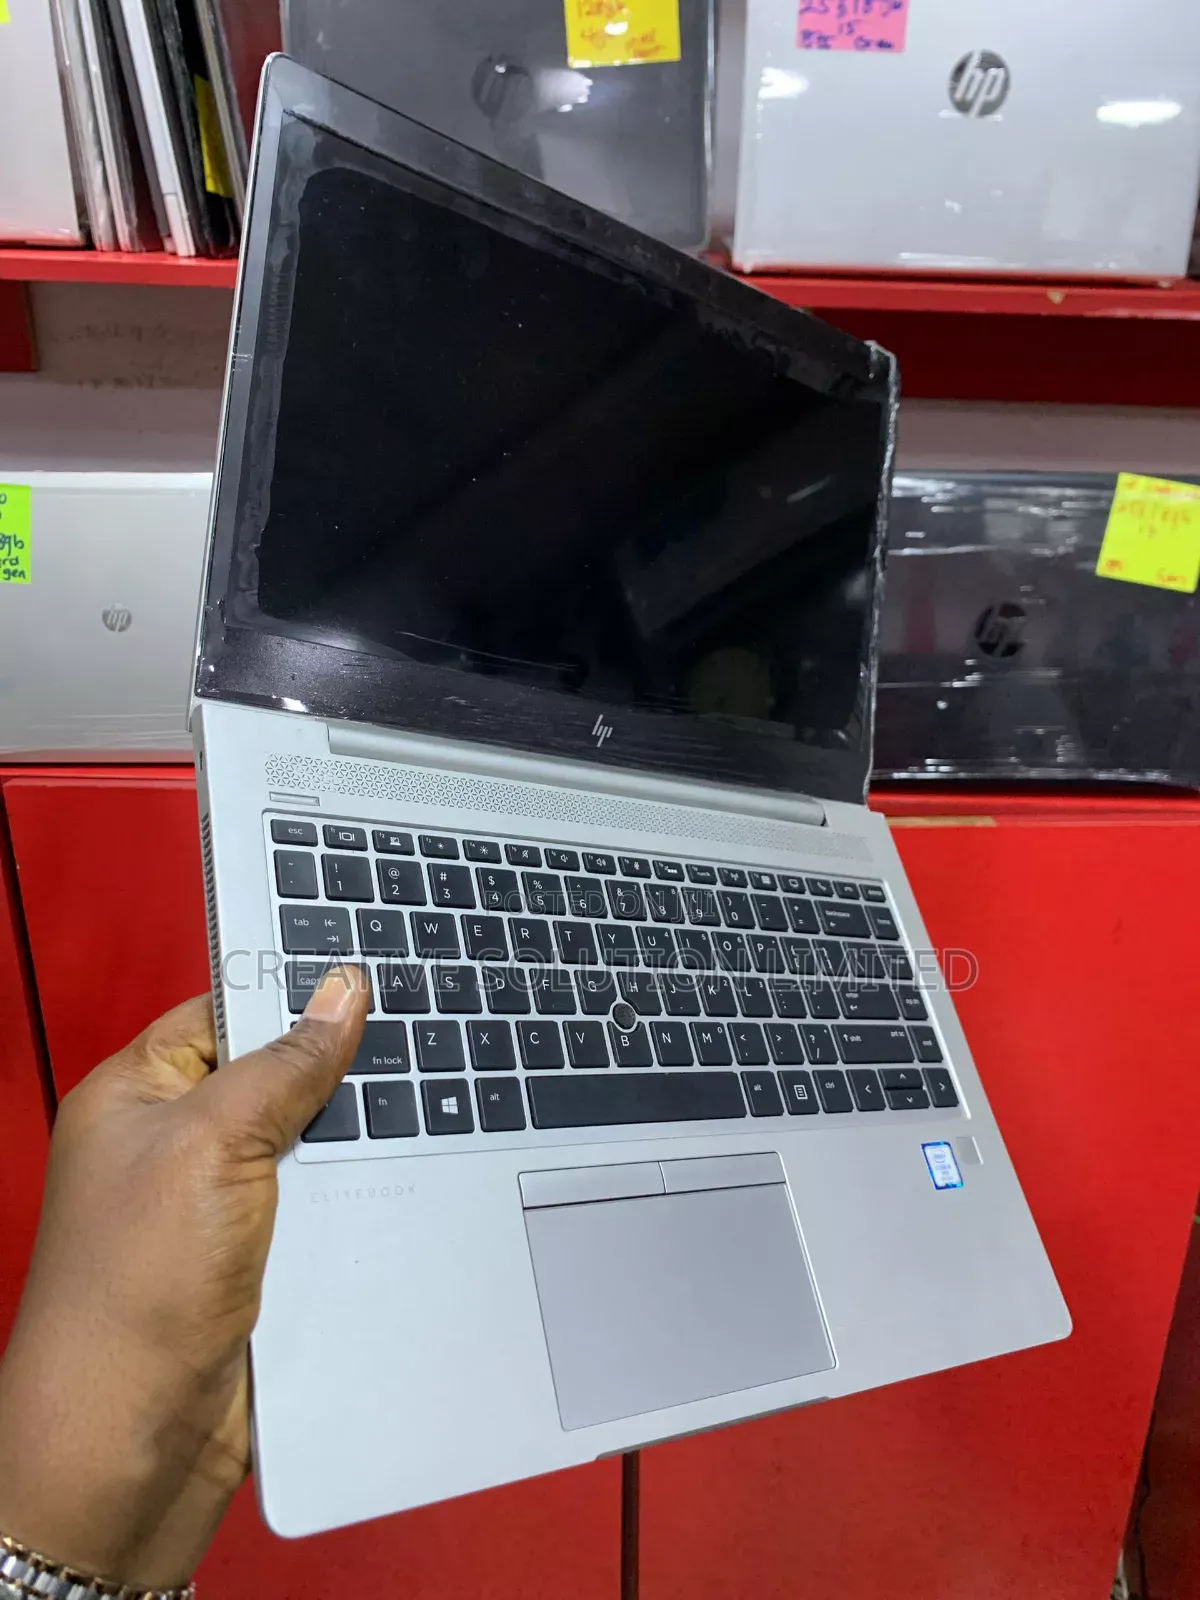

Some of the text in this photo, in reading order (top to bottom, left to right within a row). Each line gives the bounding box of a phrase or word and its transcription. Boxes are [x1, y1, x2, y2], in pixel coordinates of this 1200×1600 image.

[950, 49, 1009, 118] hp
[0, 556, 19, 568] rd
[102, 605, 132, 632] hp
[591, 714, 613, 748] hp
[288, 826, 303, 836] esc
[388, 867, 400, 879] @
[440, 871, 447, 881] #
[337, 880, 342, 891] 1
[488, 875, 495, 886] $
[533, 880, 543, 890] %
[392, 885, 400, 895] 2
[443, 888, 451, 899] 3
[616, 887, 624, 897] &
[492, 892, 499, 902] 4
[537, 895, 544, 905] 5
[579, 898, 587, 909] 6
[620, 902, 626, 912] 7
[659, 905, 666, 915] 8
[696, 908, 703, 918] 9
[294, 918, 309, 926] tab
[370, 919, 382, 932] Q
[423, 922, 439, 935] W
[473, 925, 483, 937] E
[520, 928, 530, 939] R
[564, 930, 572, 941] T
[607, 933, 616, 944] Y
[647, 936, 656, 947] U
[722, 940, 732, 951] O
[757, 943, 764, 952] P
[392, 976, 404, 988] A
[445, 976, 454, 988] S
[495, 978, 505, 989] D
[542, 979, 550, 990] F
[587, 980, 597, 992] G
[629, 981, 638, 993] H
[670, 984, 676, 994] J
[707, 984, 717, 995] K
[744, 987, 752, 997] L
[427, 1032, 437, 1045] Z
[480, 1032, 490, 1045] X
[530, 1032, 540, 1045] C
[575, 1032, 585, 1044] V
[621, 1035, 630, 1047] B
[661, 1032, 671, 1044] N
[702, 1032, 712, 1044] M
[372, 1055, 403, 1065] fn lock
[378, 1097, 388, 1106] fn
[490, 1092, 500, 1101] alt
[310, 1184, 416, 1203] ELITEBOOK
